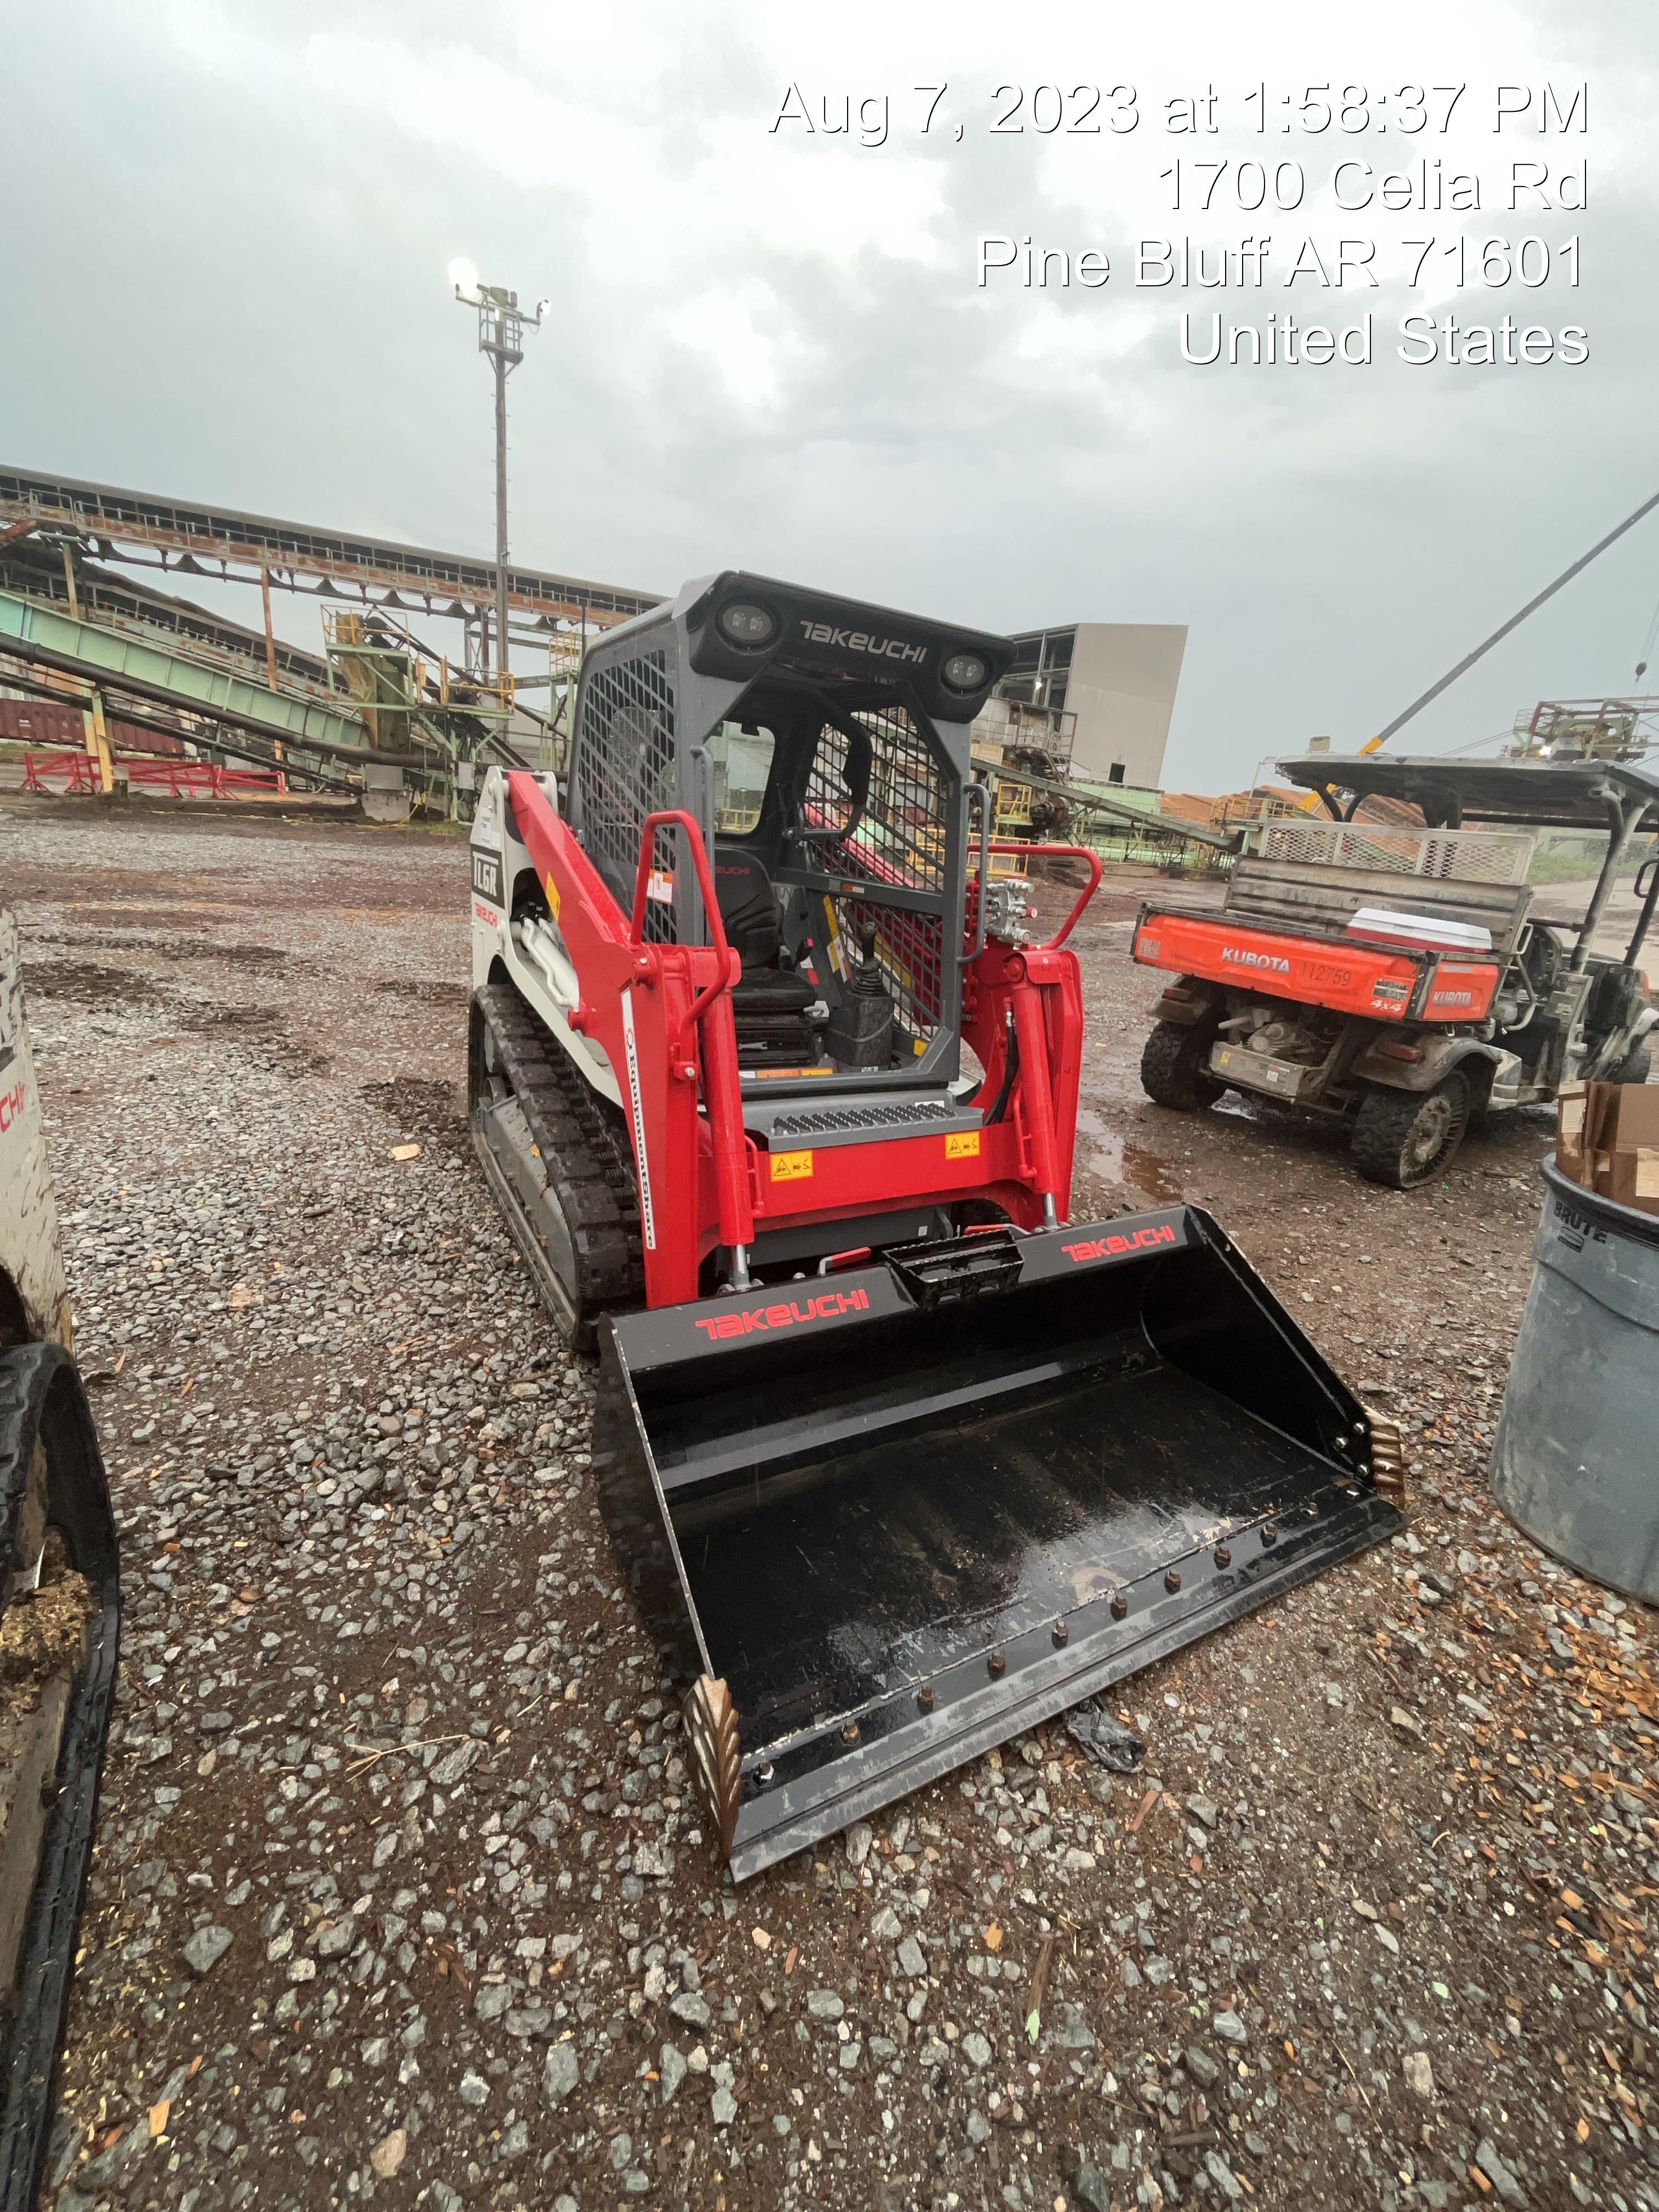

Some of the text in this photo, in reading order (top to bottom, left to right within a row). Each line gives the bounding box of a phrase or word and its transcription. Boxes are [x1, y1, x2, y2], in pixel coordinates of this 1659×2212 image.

[472, 851, 499, 897] TL6R
[1221, 947, 1290, 974] KUBOTA
[1553, 1200, 1607, 1244] BRUTE
